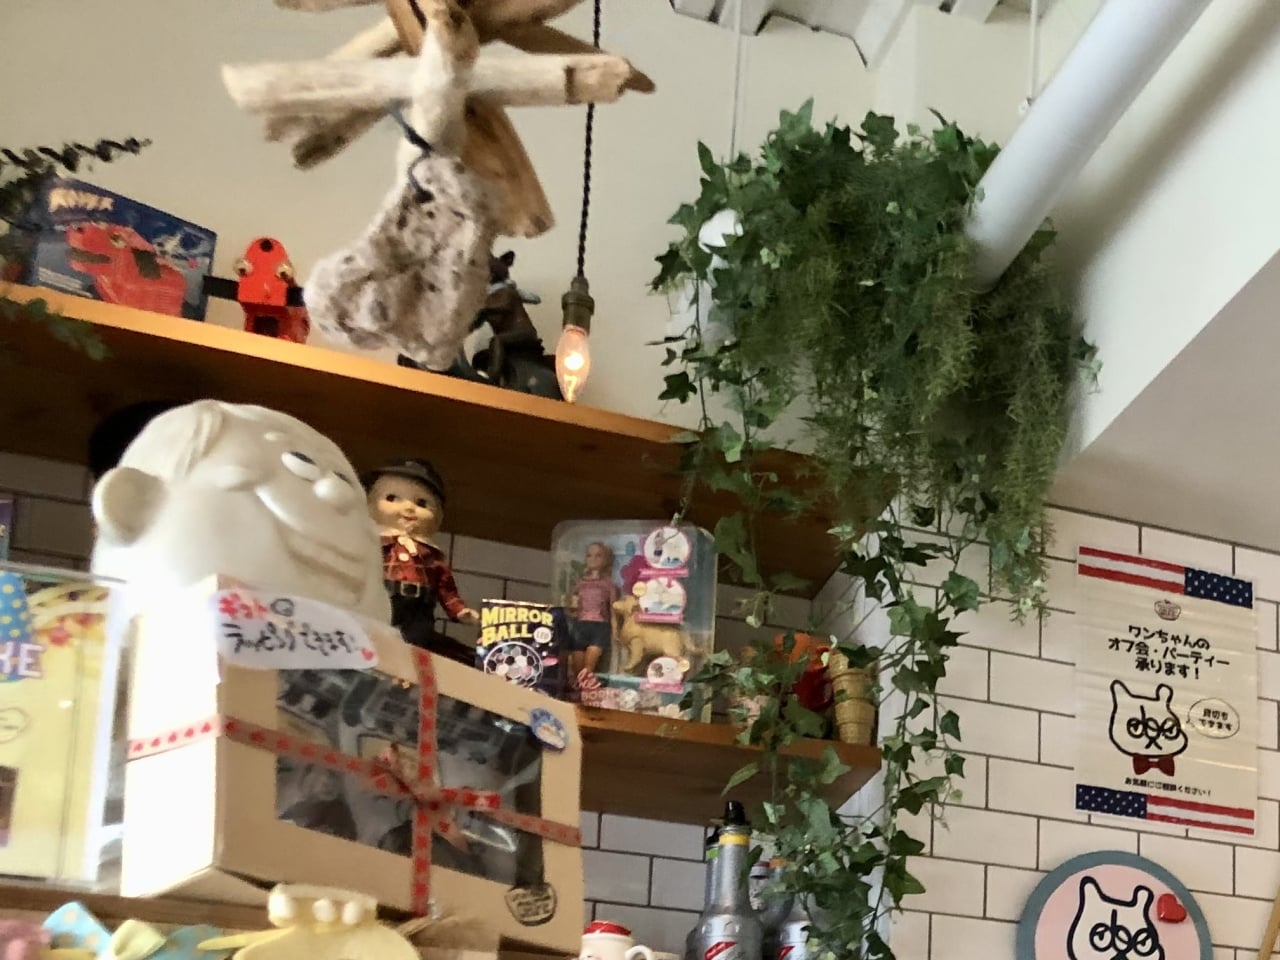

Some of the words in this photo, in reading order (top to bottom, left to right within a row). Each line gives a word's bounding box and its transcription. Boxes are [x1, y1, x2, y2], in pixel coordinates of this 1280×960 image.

[481, 605, 555, 629] MIRROR
[481, 626, 533, 648] BALL
[1128, 624, 1210, 651] ワンちゃんの
[1107, 637, 1231, 667] オフ会・パーティー
